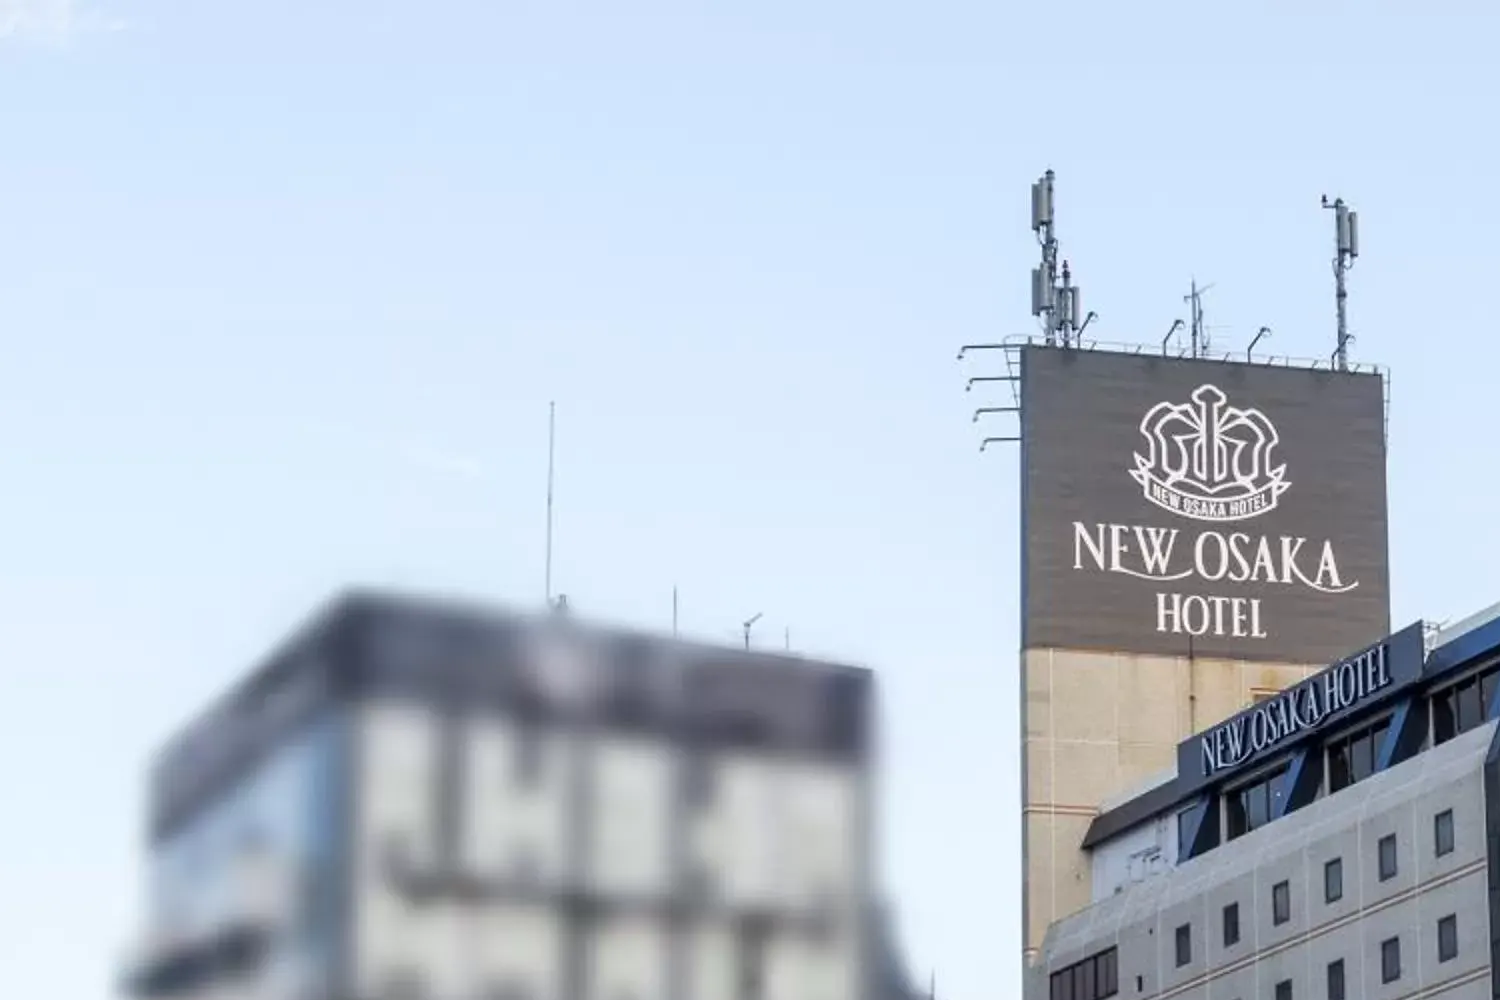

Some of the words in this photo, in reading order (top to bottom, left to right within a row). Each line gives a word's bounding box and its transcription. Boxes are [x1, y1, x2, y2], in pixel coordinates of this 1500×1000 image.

[1152, 484, 1181, 509] NEW
[1183, 498, 1227, 517] OSAKA
[1229, 493, 1268, 515] HOTEL
[1072, 521, 1193, 580] NEW
[1194, 531, 1359, 593] OSAKA
[1156, 593, 1267, 638] HOTEL
[1202, 716, 1252, 776] NEW
[1250, 682, 1325, 751] OSAKA
[1324, 644, 1390, 714] HOTEL
